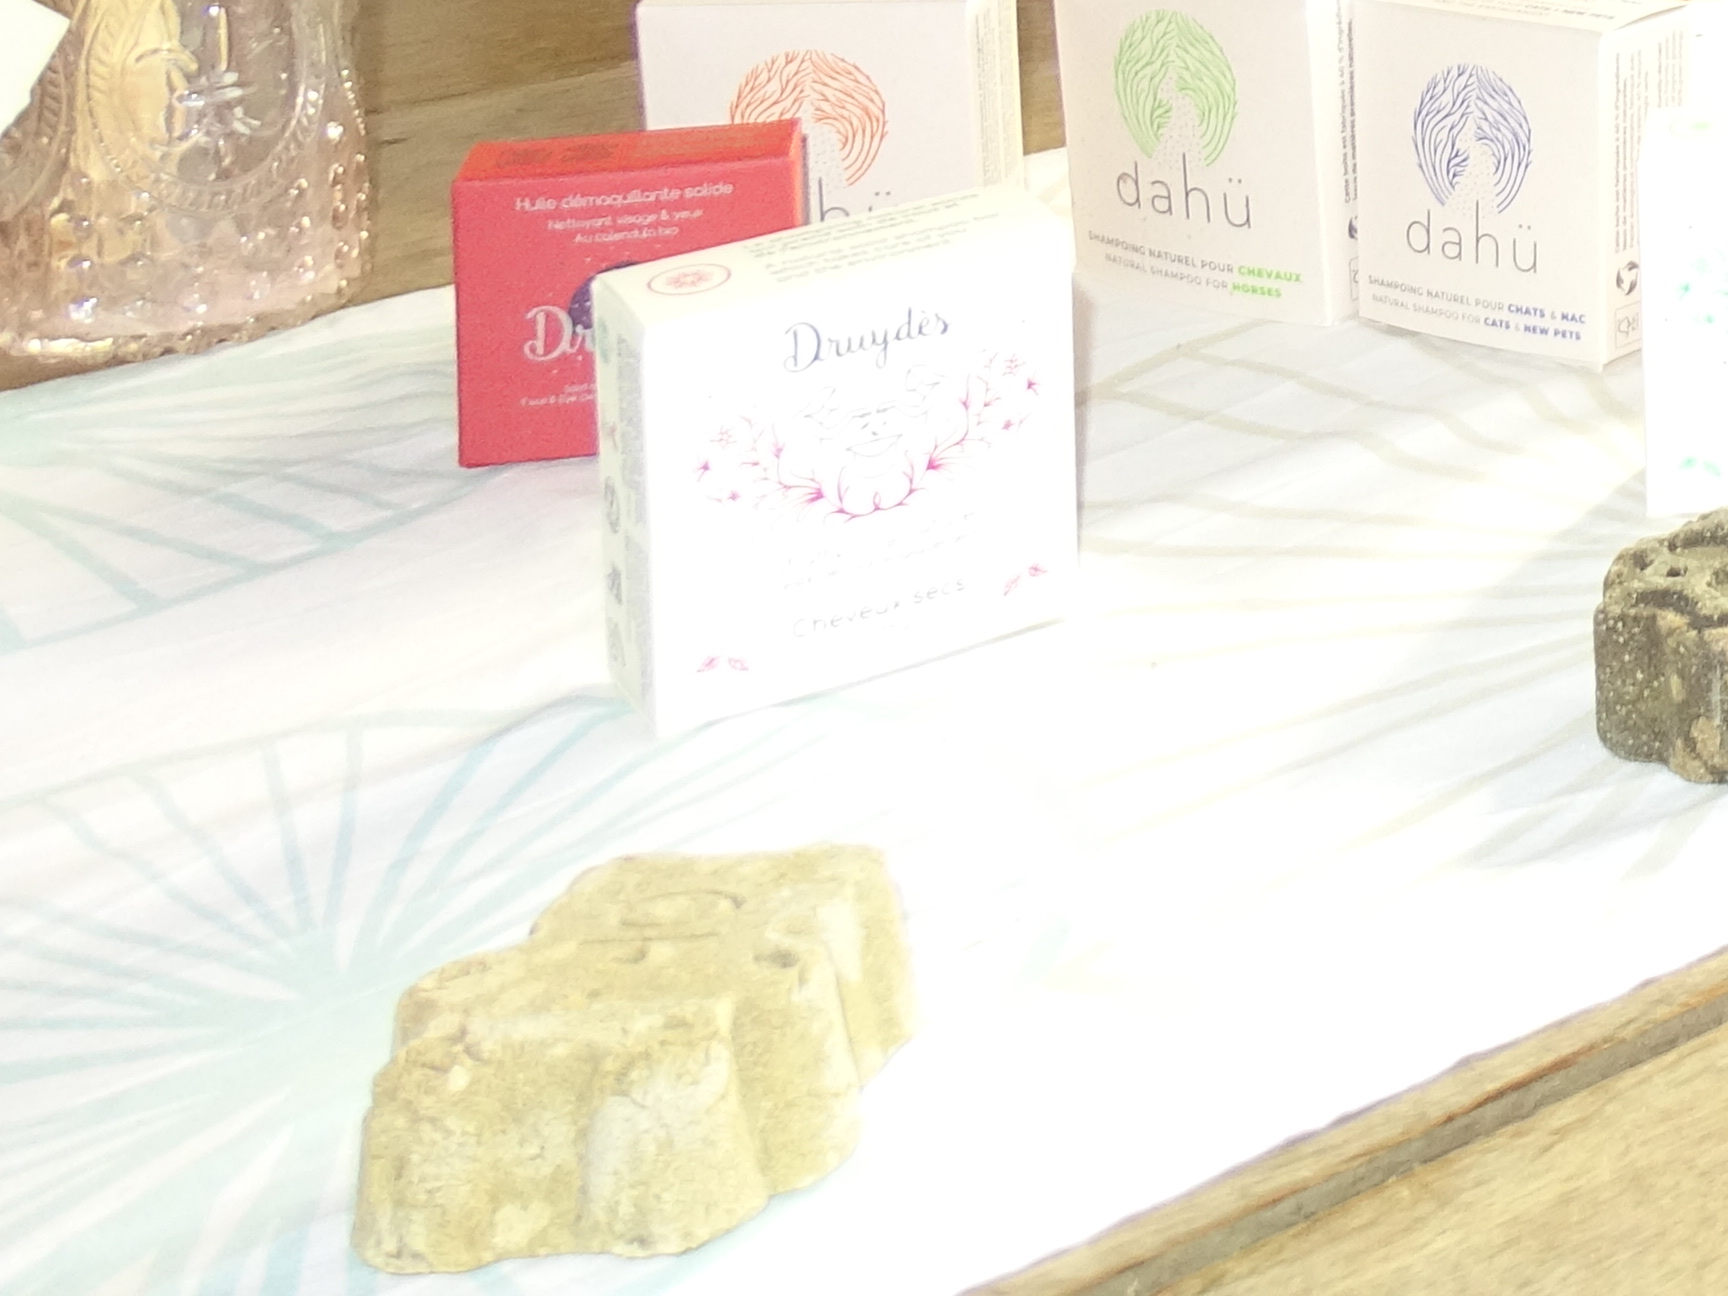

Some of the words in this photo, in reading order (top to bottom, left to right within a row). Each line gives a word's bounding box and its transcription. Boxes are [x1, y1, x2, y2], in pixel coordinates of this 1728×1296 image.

[514, 195, 556, 212] Huile
[561, 185, 681, 210] démaquillante
[684, 181, 734, 200] solide
[1116, 152, 1251, 229] dahü
[1088, 230, 1146, 256] SHAMPOING
[1149, 248, 1197, 268] NATUREL
[1201, 259, 1234, 274] POUR
[1237, 264, 1302, 283] CHEVAUX
[1406, 199, 1538, 274] dahü
[1105, 253, 1147, 274] NATURAL
[1150, 266, 1202, 286] SHAMPOO
[1205, 277, 1228, 290] FOR
[1231, 281, 1283, 298] HORSES
[1368, 274, 1424, 297] SHAMPOING
[1427, 288, 1471, 307] NATUREL
[1475, 297, 1504, 312] POUR
[1507, 303, 1546, 319] CHATS
[1561, 312, 1586, 325] NAC
[783, 306, 952, 372] Druydès
[1372, 292, 1411, 311] NATURAL
[1412, 302, 1459, 321] SHAMPOO
[1462, 311, 1481, 324] FOR
[1483, 317, 1511, 330] CATS
[1524, 324, 1549, 336] NEW
[1553, 328, 1582, 341] PETS
